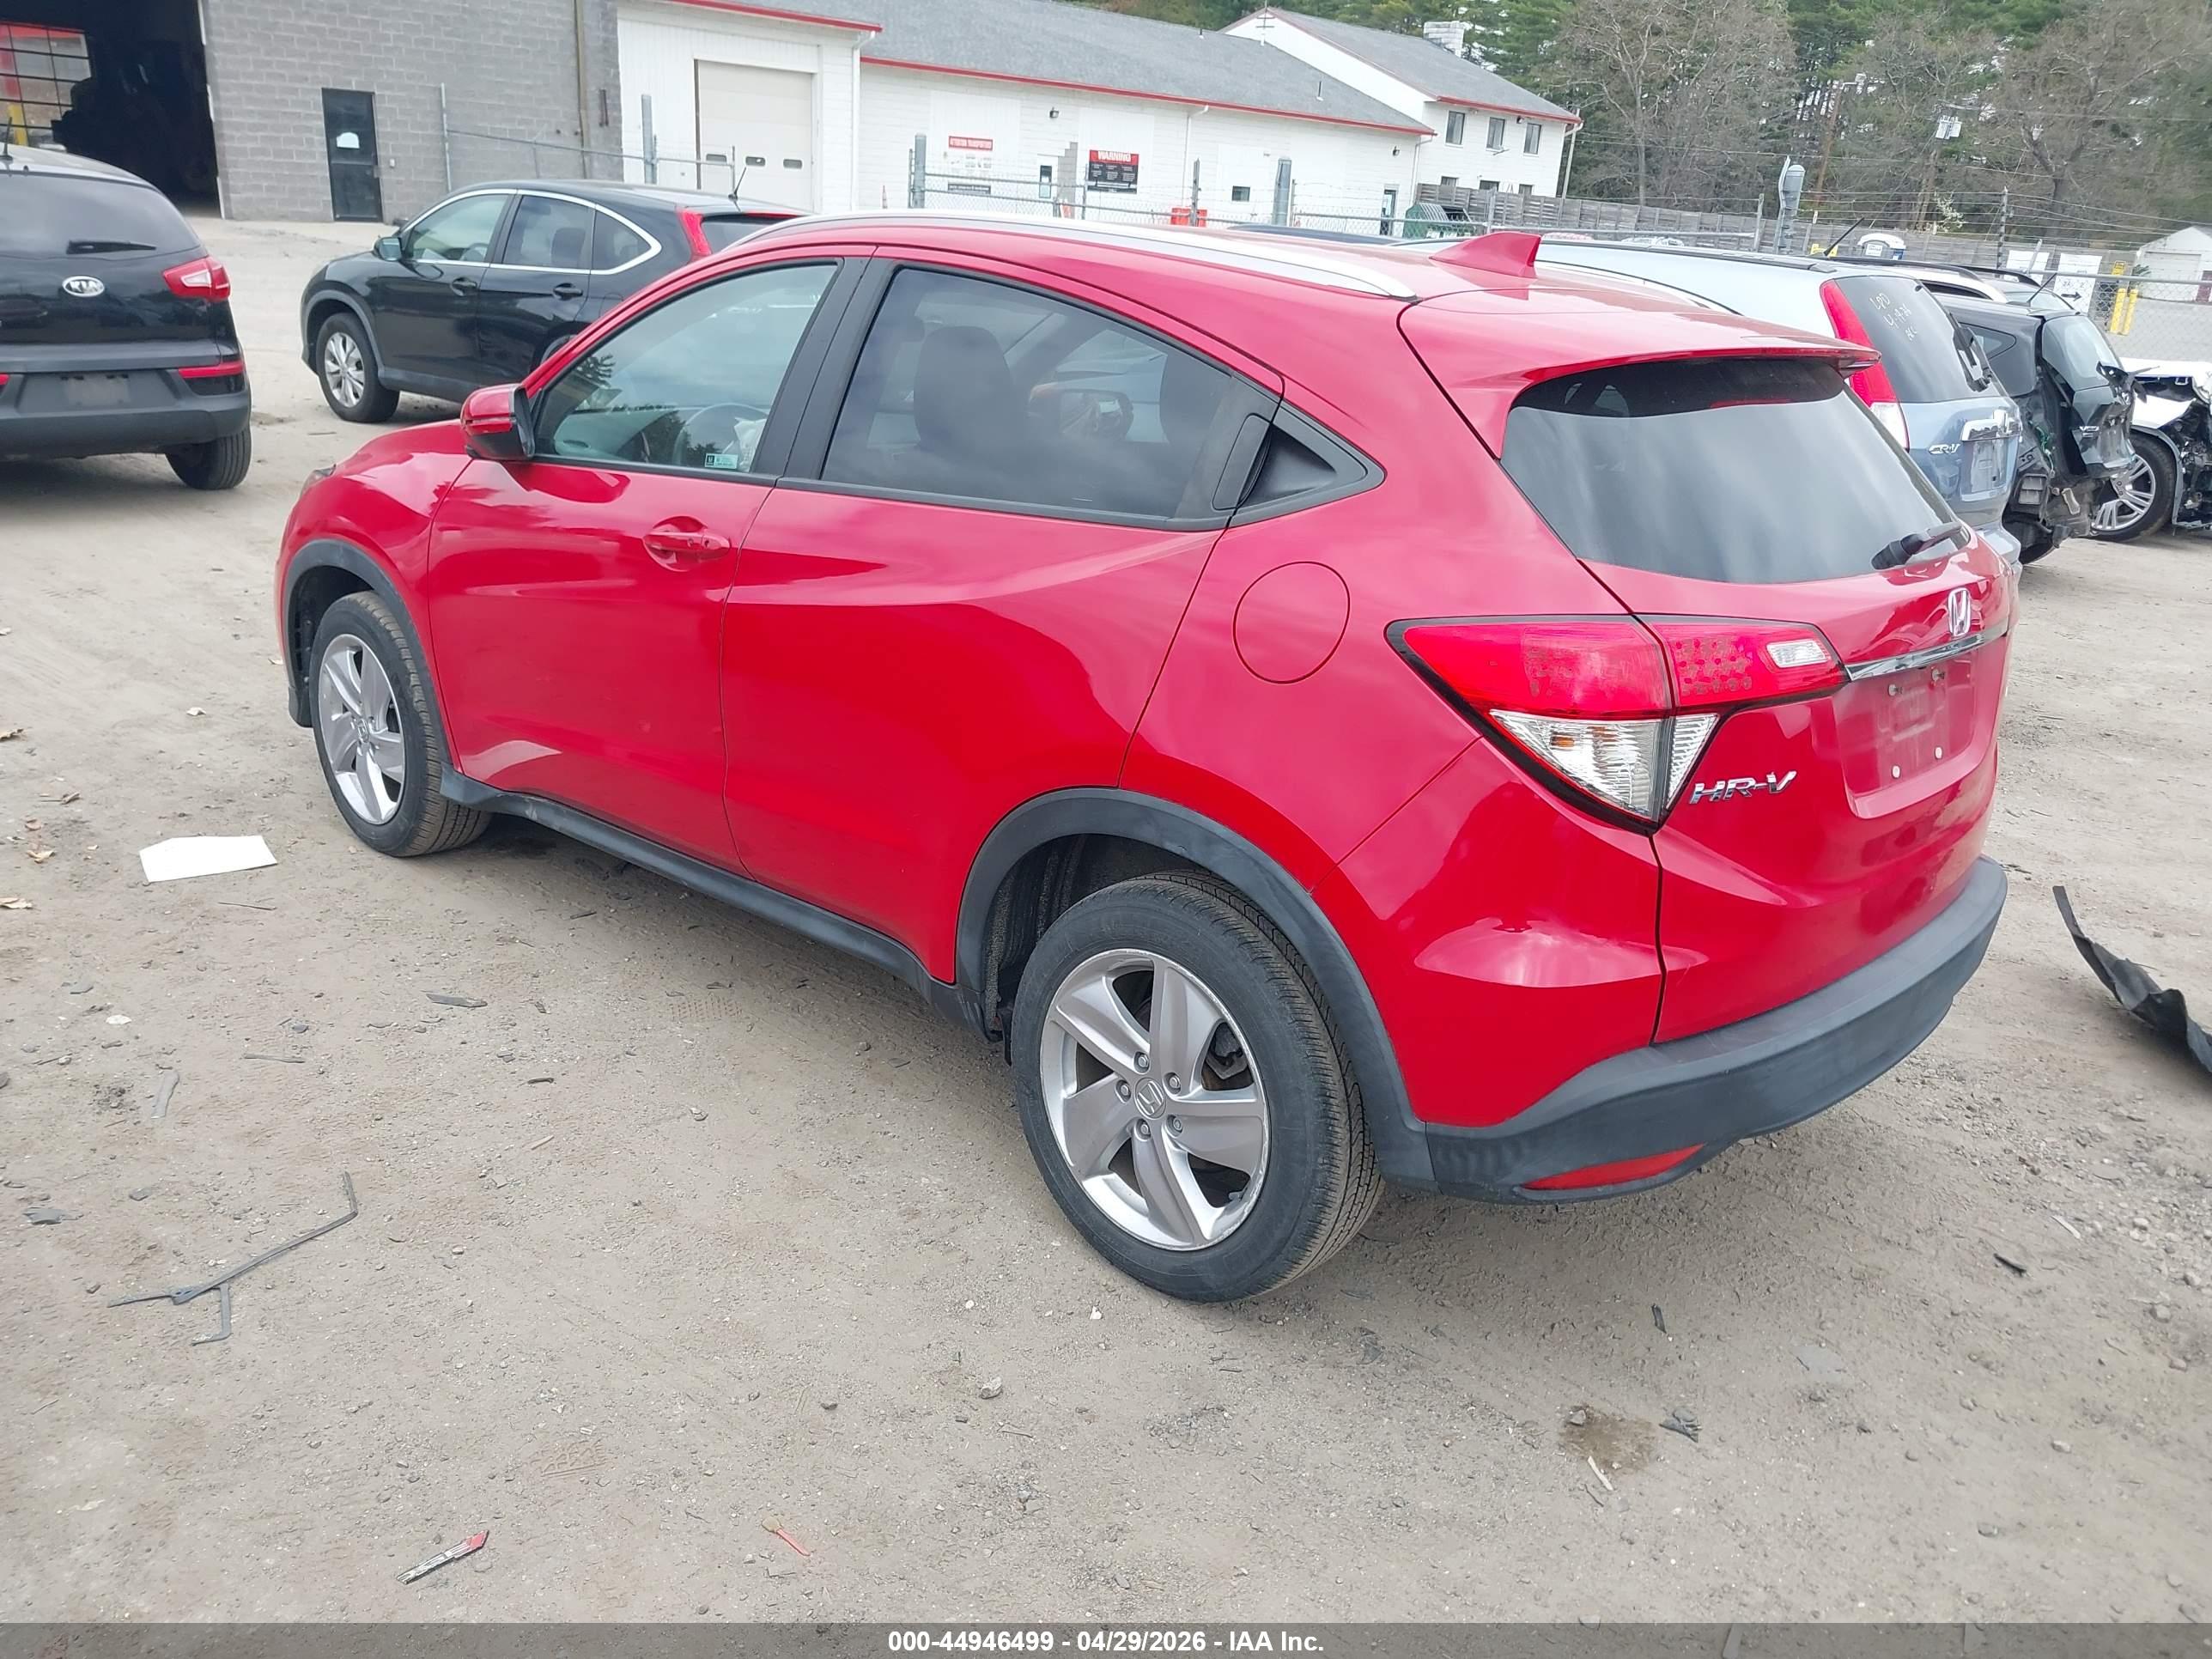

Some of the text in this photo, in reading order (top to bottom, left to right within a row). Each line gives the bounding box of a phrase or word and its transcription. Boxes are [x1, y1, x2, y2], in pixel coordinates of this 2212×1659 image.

[68, 279, 100, 294] KIA
[1929, 443, 1961, 455] CR-V
[1689, 771, 1797, 805] HR-V
